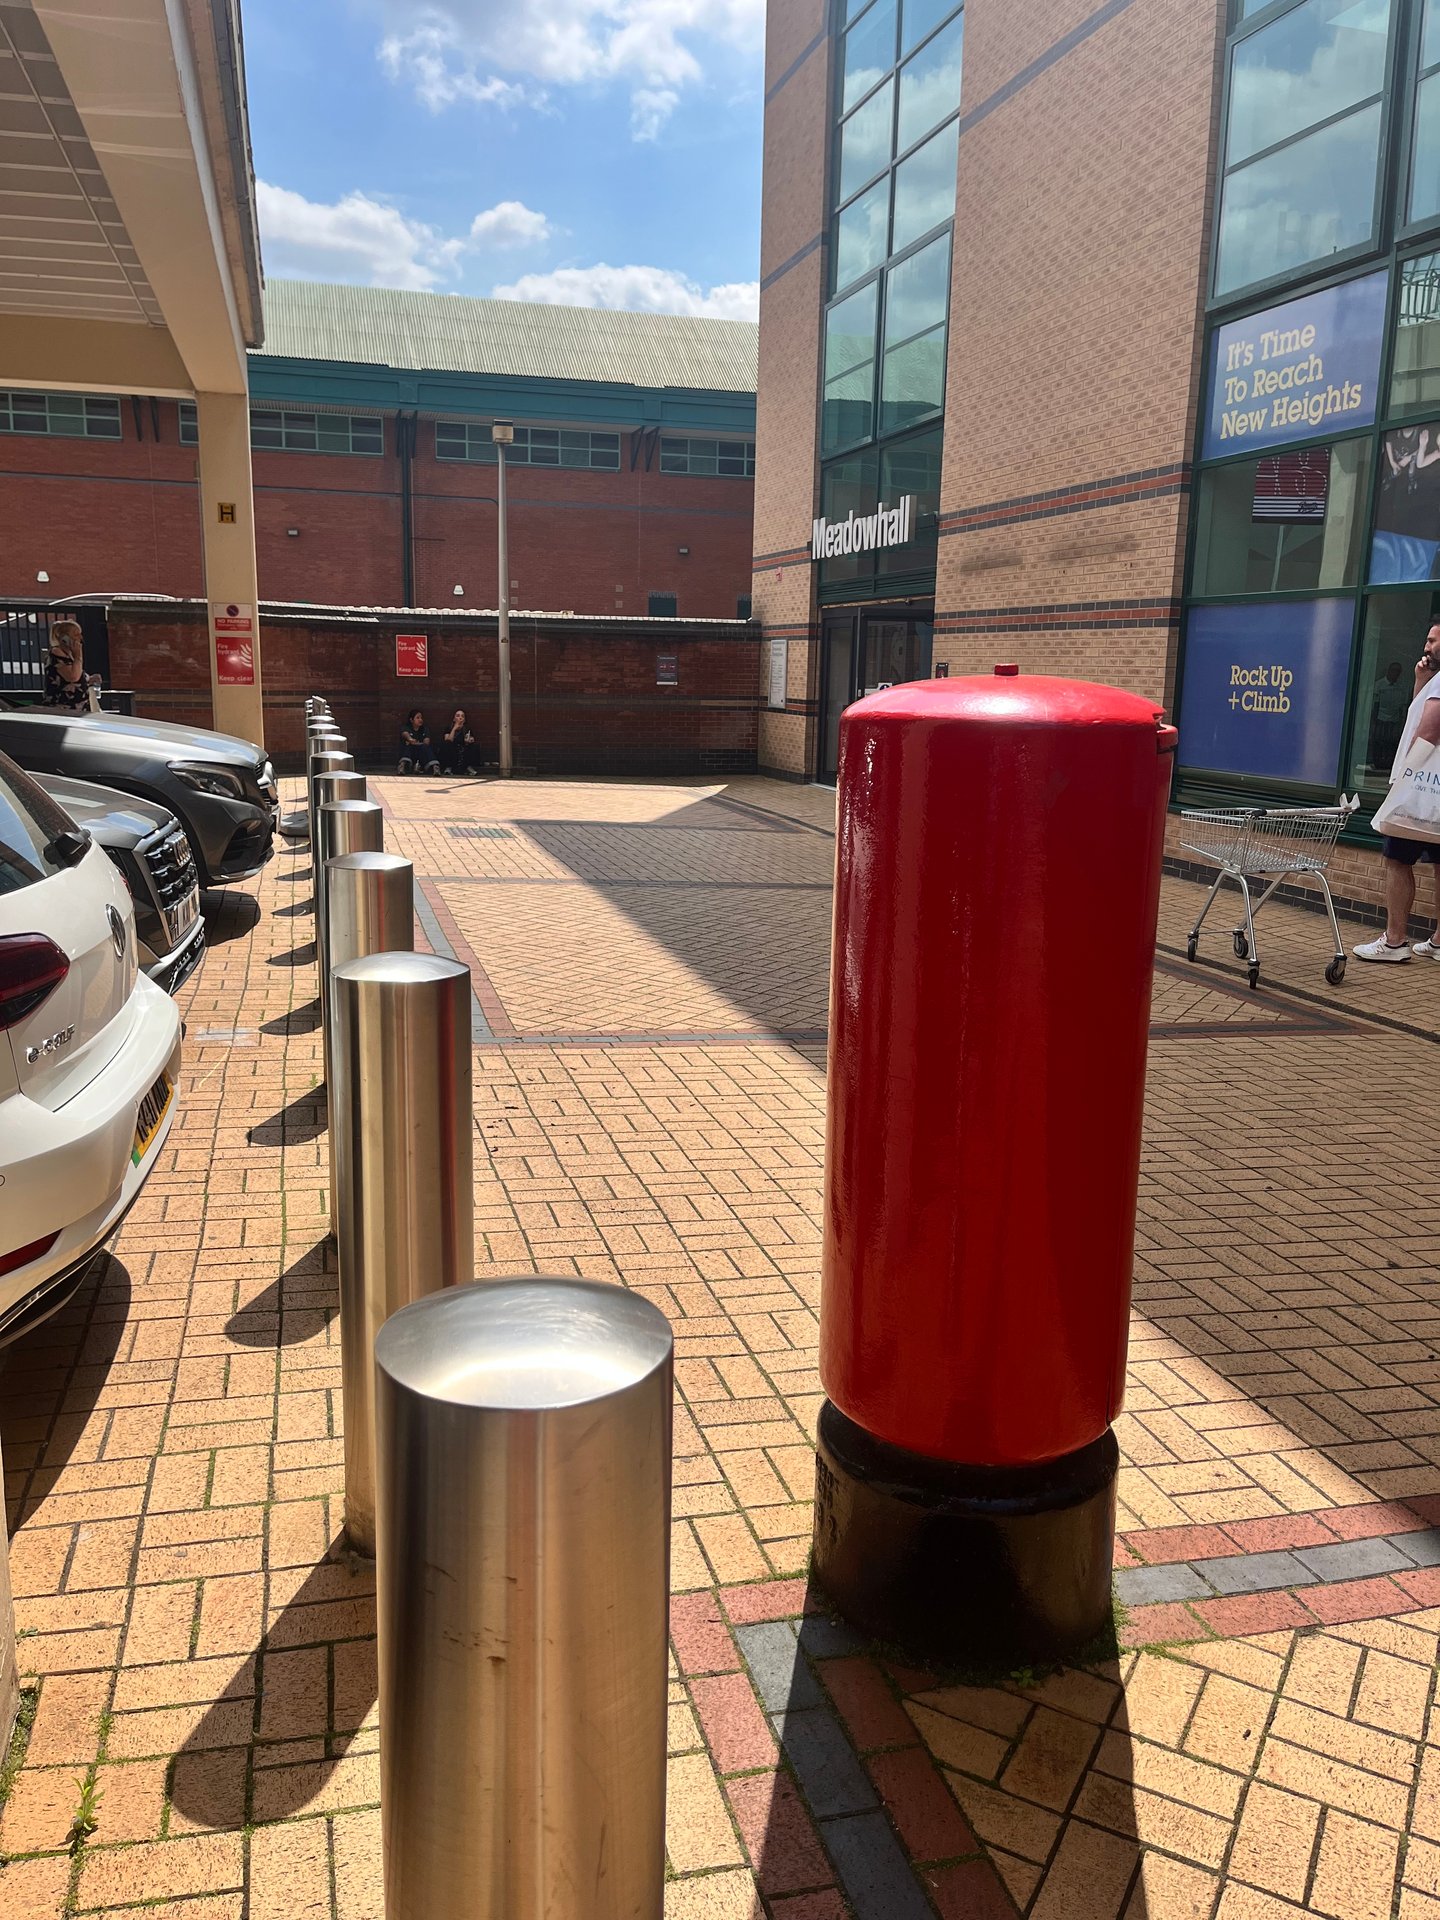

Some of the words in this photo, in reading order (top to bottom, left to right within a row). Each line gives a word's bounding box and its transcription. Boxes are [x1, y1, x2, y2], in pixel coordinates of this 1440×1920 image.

[1226, 341, 1254, 372] It's
[1260, 324, 1316, 361] Time
[1224, 376, 1248, 405] To
[1251, 354, 1324, 398] Reach
[1220, 407, 1268, 440] New
[1270, 381, 1362, 426] Heights
[220, 504, 234, 522] H
[812, 495, 913, 560] Meadowhall
[1229, 665, 1269, 687] Rock
[1270, 665, 1294, 692] Up
